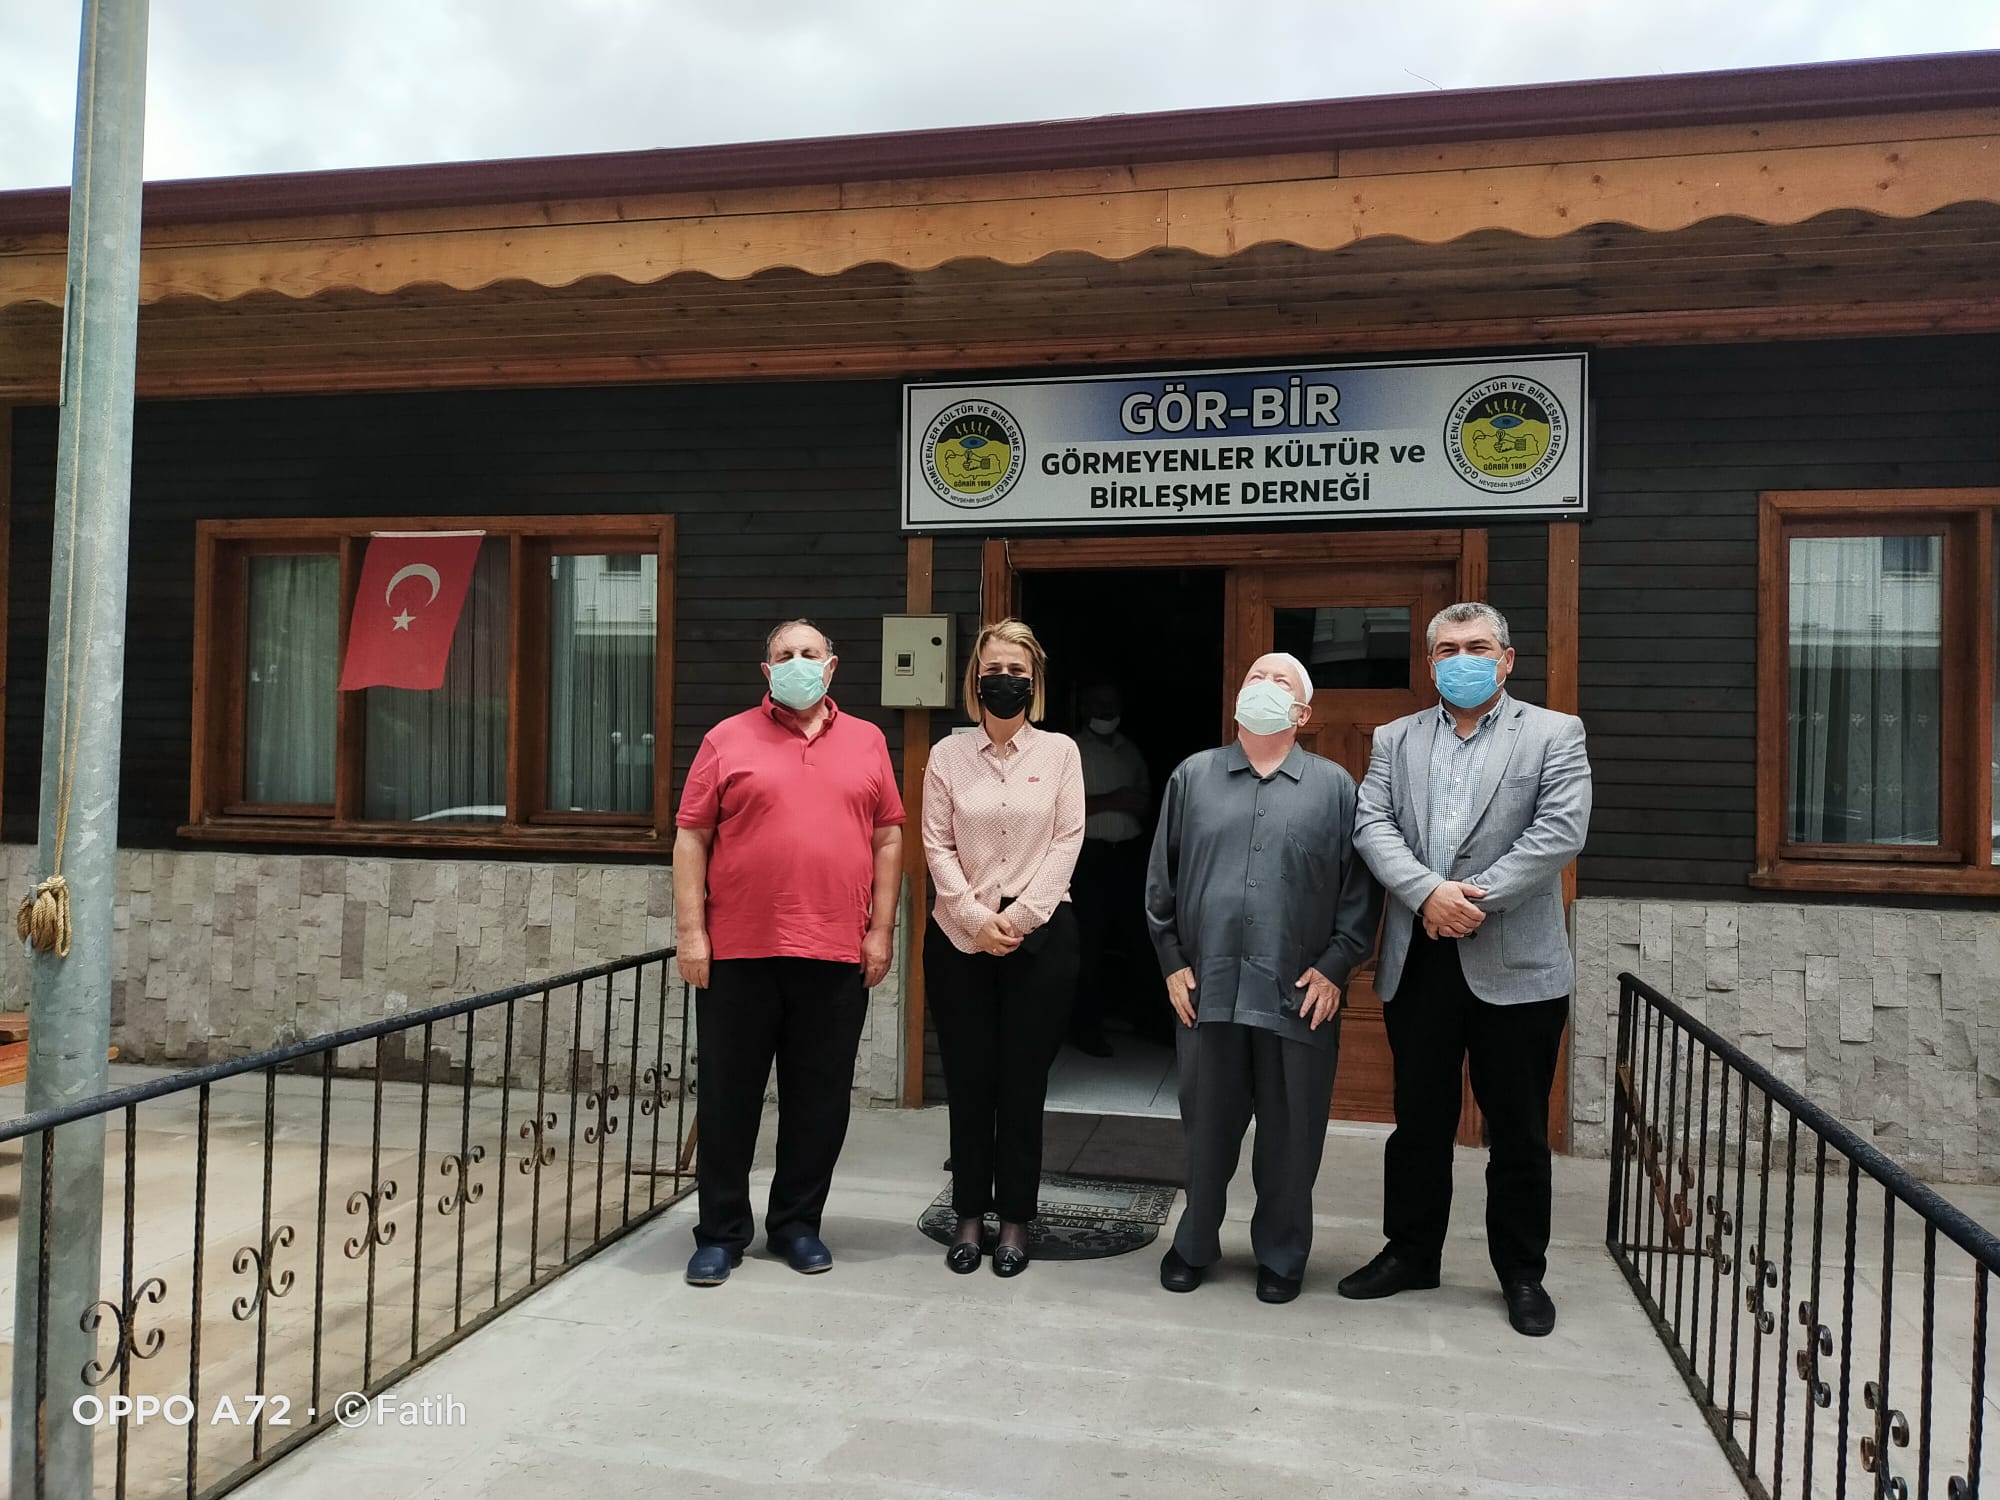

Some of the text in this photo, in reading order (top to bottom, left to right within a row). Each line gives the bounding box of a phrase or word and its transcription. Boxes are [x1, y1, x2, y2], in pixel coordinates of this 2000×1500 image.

[1120, 376, 1341, 434] GÖR-BİR
[1449, 381, 1562, 480] GÖRMEYENLER KÜLTÜR VE BİRLEŞME DERNEĞİ
[925, 404, 1021, 497] GÖRMEYENLER KÜLTÜR VE BİRLEŞME DERNEĞİ
[1041, 437, 1426, 476] GÖRMEYENLER KÜLTÜR ve
[1090, 472, 1370, 512] BİRLEŞME DERNEĞİ
